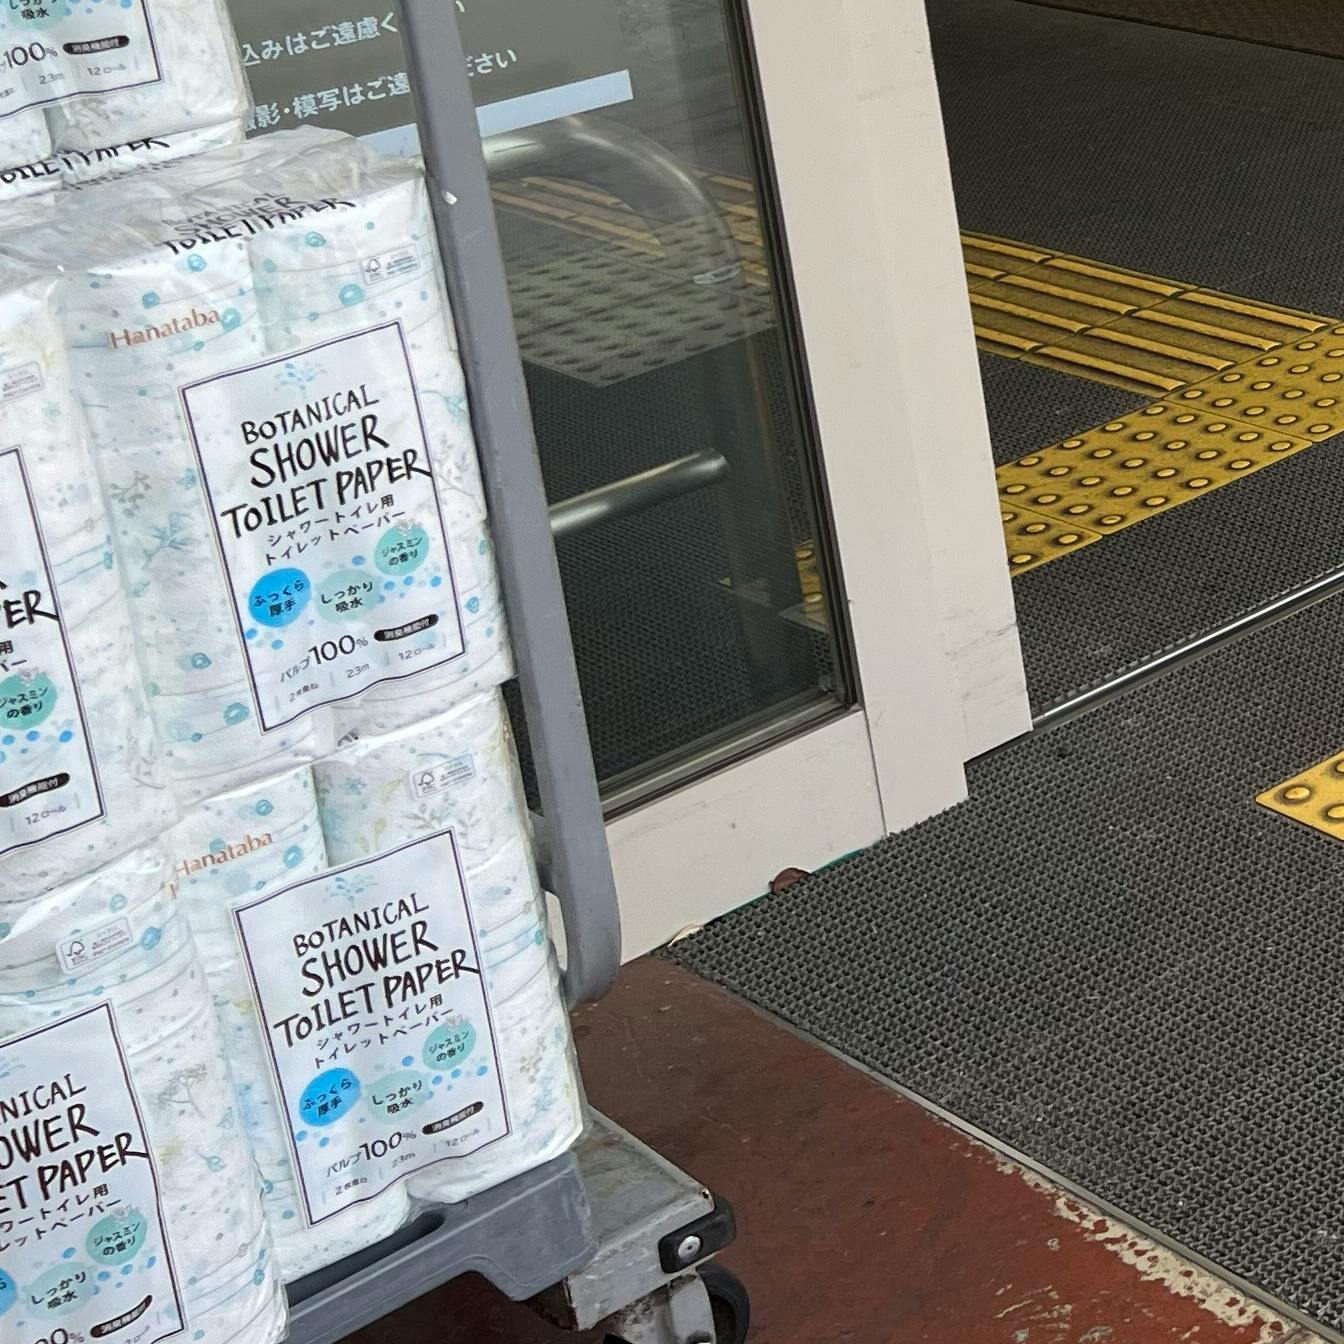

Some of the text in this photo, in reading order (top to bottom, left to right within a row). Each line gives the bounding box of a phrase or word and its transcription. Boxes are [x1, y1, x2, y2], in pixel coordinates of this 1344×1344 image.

[21, 6, 50, 20] 吸水
[109, 308, 221, 349] Hanataba
[240, 384, 380, 445] BOTANICAL
[250, 413, 390, 488] SHOWER
[221, 448, 433, 539] TOILET PAPER
[268, 493, 395, 547] シャワートイレ用
[265, 511, 406, 566] トイレットペーパー
[381, 536, 423, 557] ジャスミン
[388, 548, 419, 566] の香り
[253, 580, 305, 607] ふっくら
[321, 581, 373, 604] しっかり
[335, 596, 363, 613] 吸水
[269, 598, 296, 617] 厚手
[346, 662, 370, 679] 23m
[6, 701, 44, 720] の香り
[292, 892, 430, 958] BOTANICAL
[301, 919, 439, 997] SHOWER
[273, 948, 480, 1048] TOILET PAPER
[317, 993, 443, 1050] シャワートイレ用
[314, 1008, 454, 1069] トイレットペーパー
[429, 1030, 470, 1054] ジャスミン
[436, 1043, 465, 1063] の香り
[303, 1078, 353, 1110] ふっくら
[372, 1079, 423, 1105] しっかり
[317, 1096, 343, 1117] 厚手
[386, 1096, 414, 1115] 吸水
[37, 1132, 149, 1202] PAPER
[93, 1221, 141, 1247] ジャスミン
[102, 1235, 136, 1256] の香り
[31, 1271, 86, 1305] しっかり
